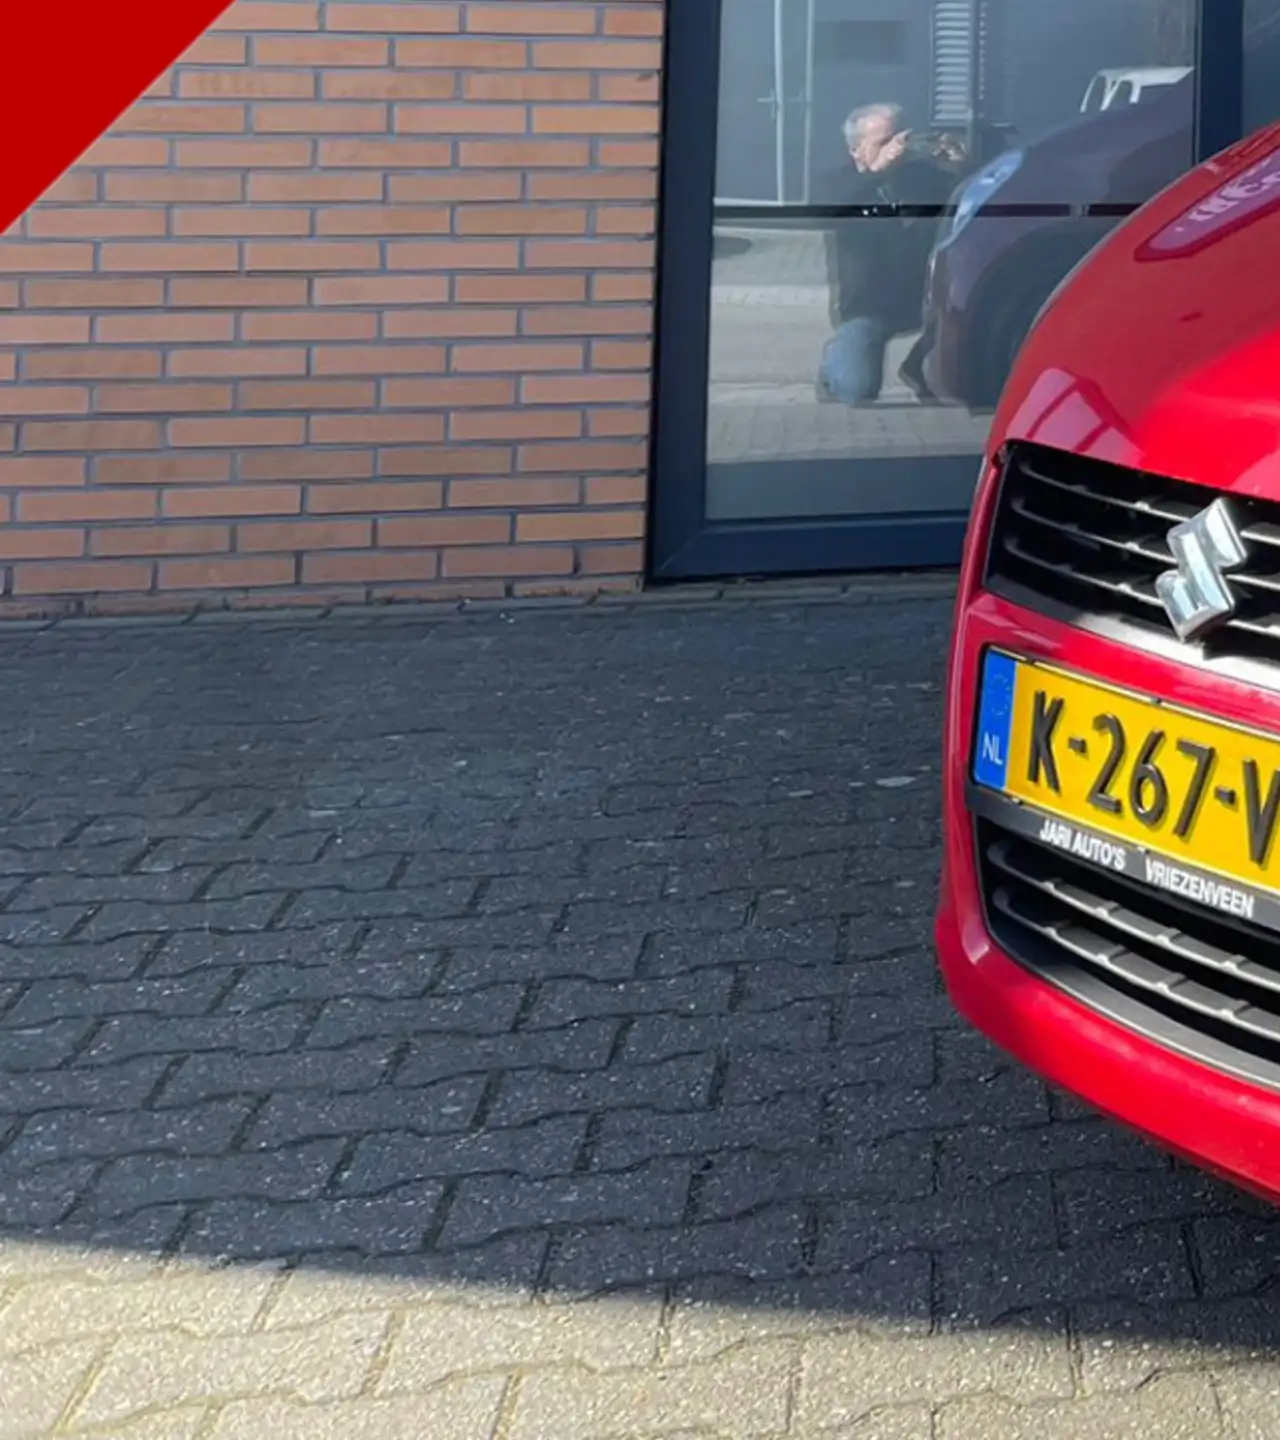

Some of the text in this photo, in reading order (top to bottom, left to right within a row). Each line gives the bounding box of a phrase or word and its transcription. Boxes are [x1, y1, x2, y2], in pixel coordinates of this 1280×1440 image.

[981, 732, 1003, 767] NL
[1039, 819, 1255, 919] JARI AUTO'S VRIEZENVEEN
